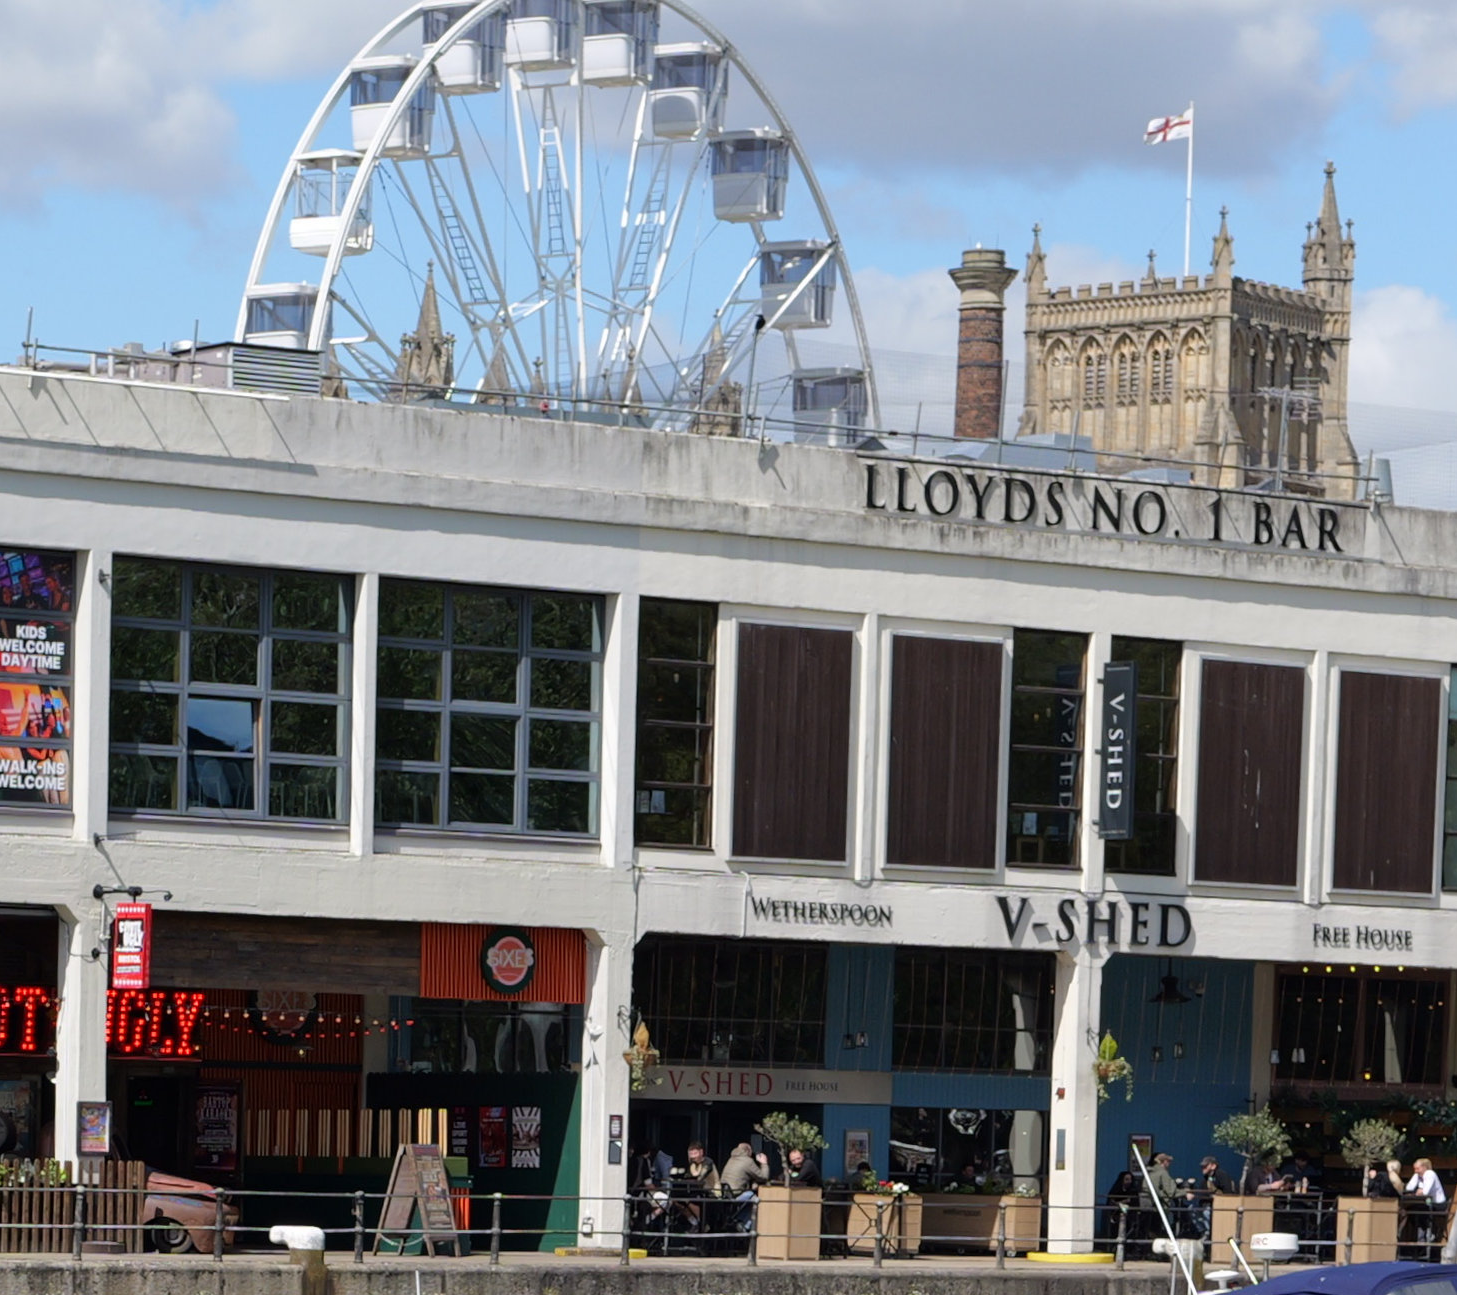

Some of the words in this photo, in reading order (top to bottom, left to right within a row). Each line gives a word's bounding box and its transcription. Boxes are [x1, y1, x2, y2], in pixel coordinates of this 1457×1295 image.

[864, 463, 1064, 527] LLOYDS
[1091, 485, 1180, 539] NO.
[1207, 493, 1223, 542] 1
[1253, 500, 1344, 553] BAR
[15, 624, 47, 640] KIDS
[0, 652, 61, 670] DAYTIME
[1106, 692, 1125, 809] V-SHED
[751, 896, 893, 924] WETHERSPOON
[995, 896, 1193, 947] V-SHED
[1312, 923, 1349, 945] FREE
[1356, 925, 1412, 947] HOUSE
[486, 948, 535, 969] SIXES
[668, 1069, 773, 1097] V-SHED
[785, 1079, 807, 1092] FREE
[808, 1080, 839, 1092] HOUSE
